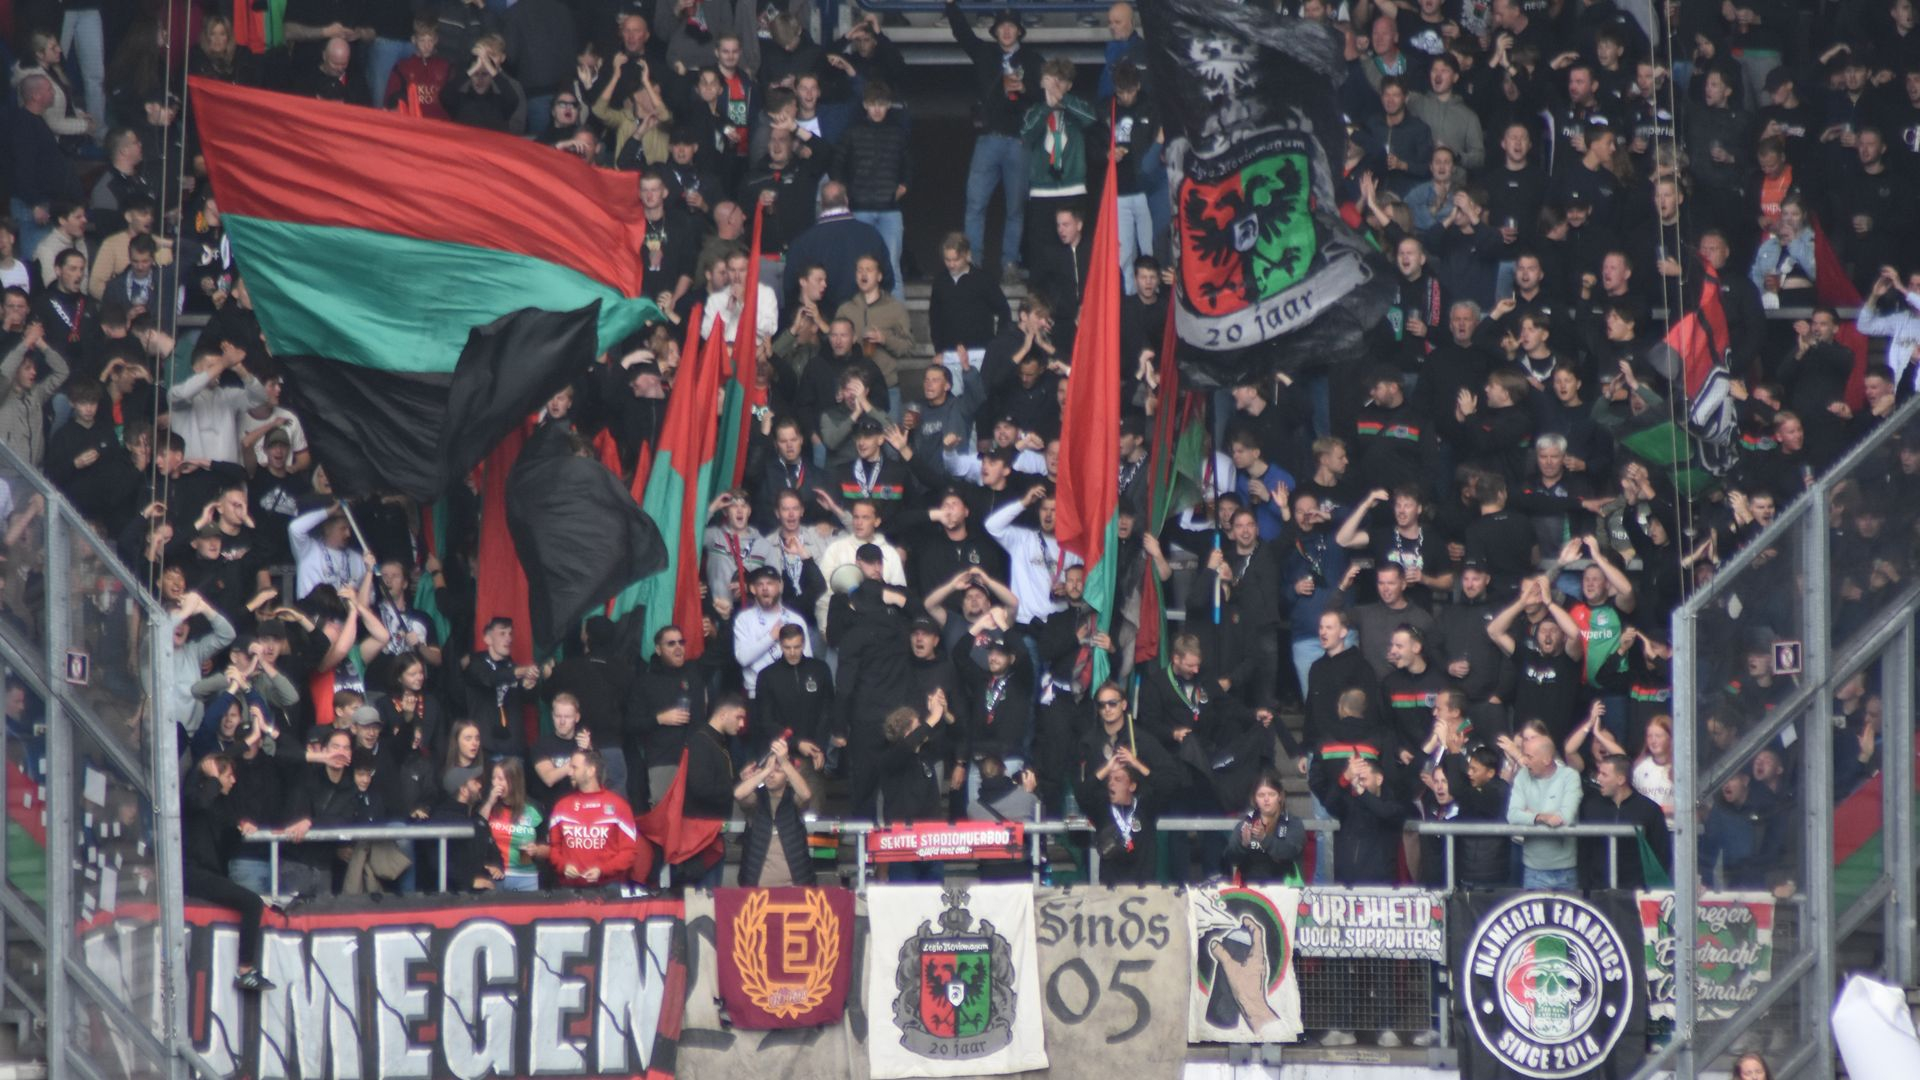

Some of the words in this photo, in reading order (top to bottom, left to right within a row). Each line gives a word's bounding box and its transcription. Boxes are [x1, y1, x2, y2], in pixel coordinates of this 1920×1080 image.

[1204, 324, 1243, 347] 20
[1254, 288, 1314, 340] jaar
[566, 837, 607, 849] GROEP
[574, 826, 610, 839] KLOK
[1036, 896, 1170, 951] Sinds
[1475, 903, 1546, 978] NIJMEGEN
[1553, 903, 1623, 982] FANATICS
[1046, 957, 1156, 1045] 05
[929, 1042, 949, 1055] 20
[954, 1040, 987, 1057] jaar
[1498, 1031, 1550, 1070] SINCE
[1555, 1034, 1600, 1070] 2014
